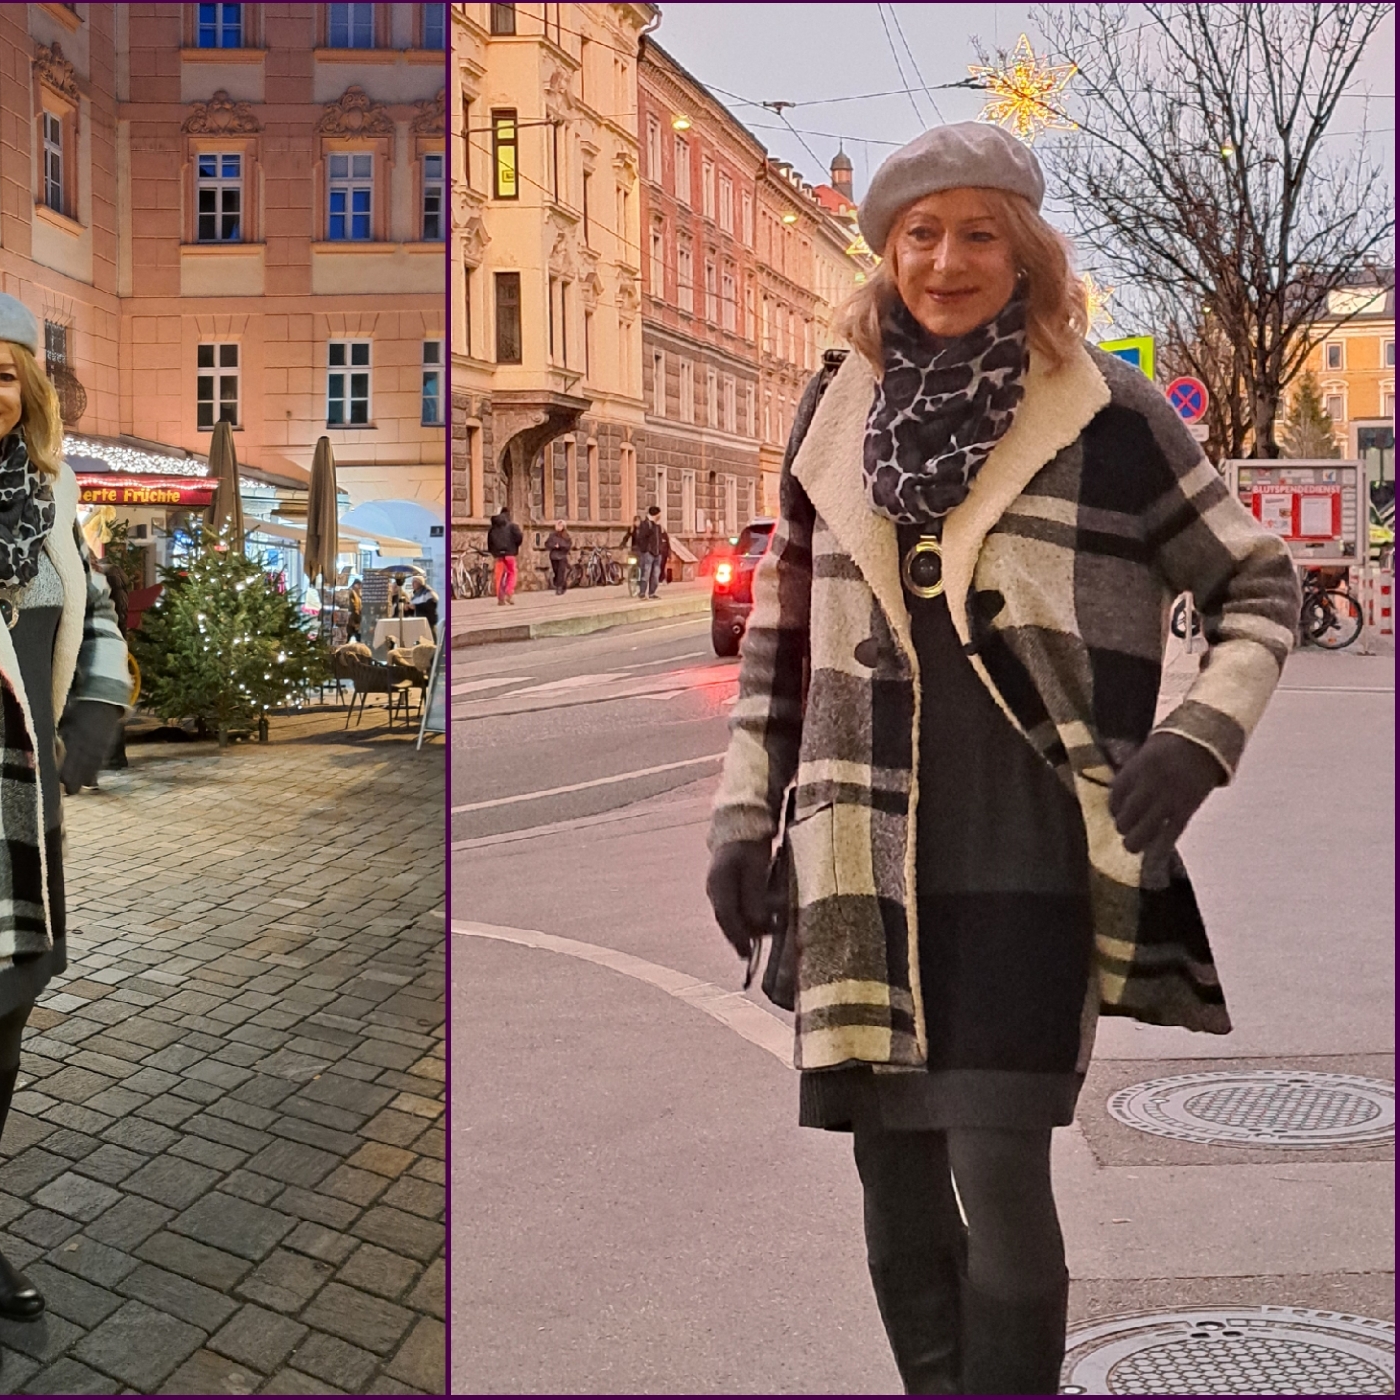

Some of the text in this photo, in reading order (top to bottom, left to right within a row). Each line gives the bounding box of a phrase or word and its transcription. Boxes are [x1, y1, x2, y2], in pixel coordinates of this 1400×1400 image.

[82, 488, 117, 502] erte
[123, 487, 181, 503] Früchte
[1252, 485, 1341, 494] BLUTSPENDEDIENST
